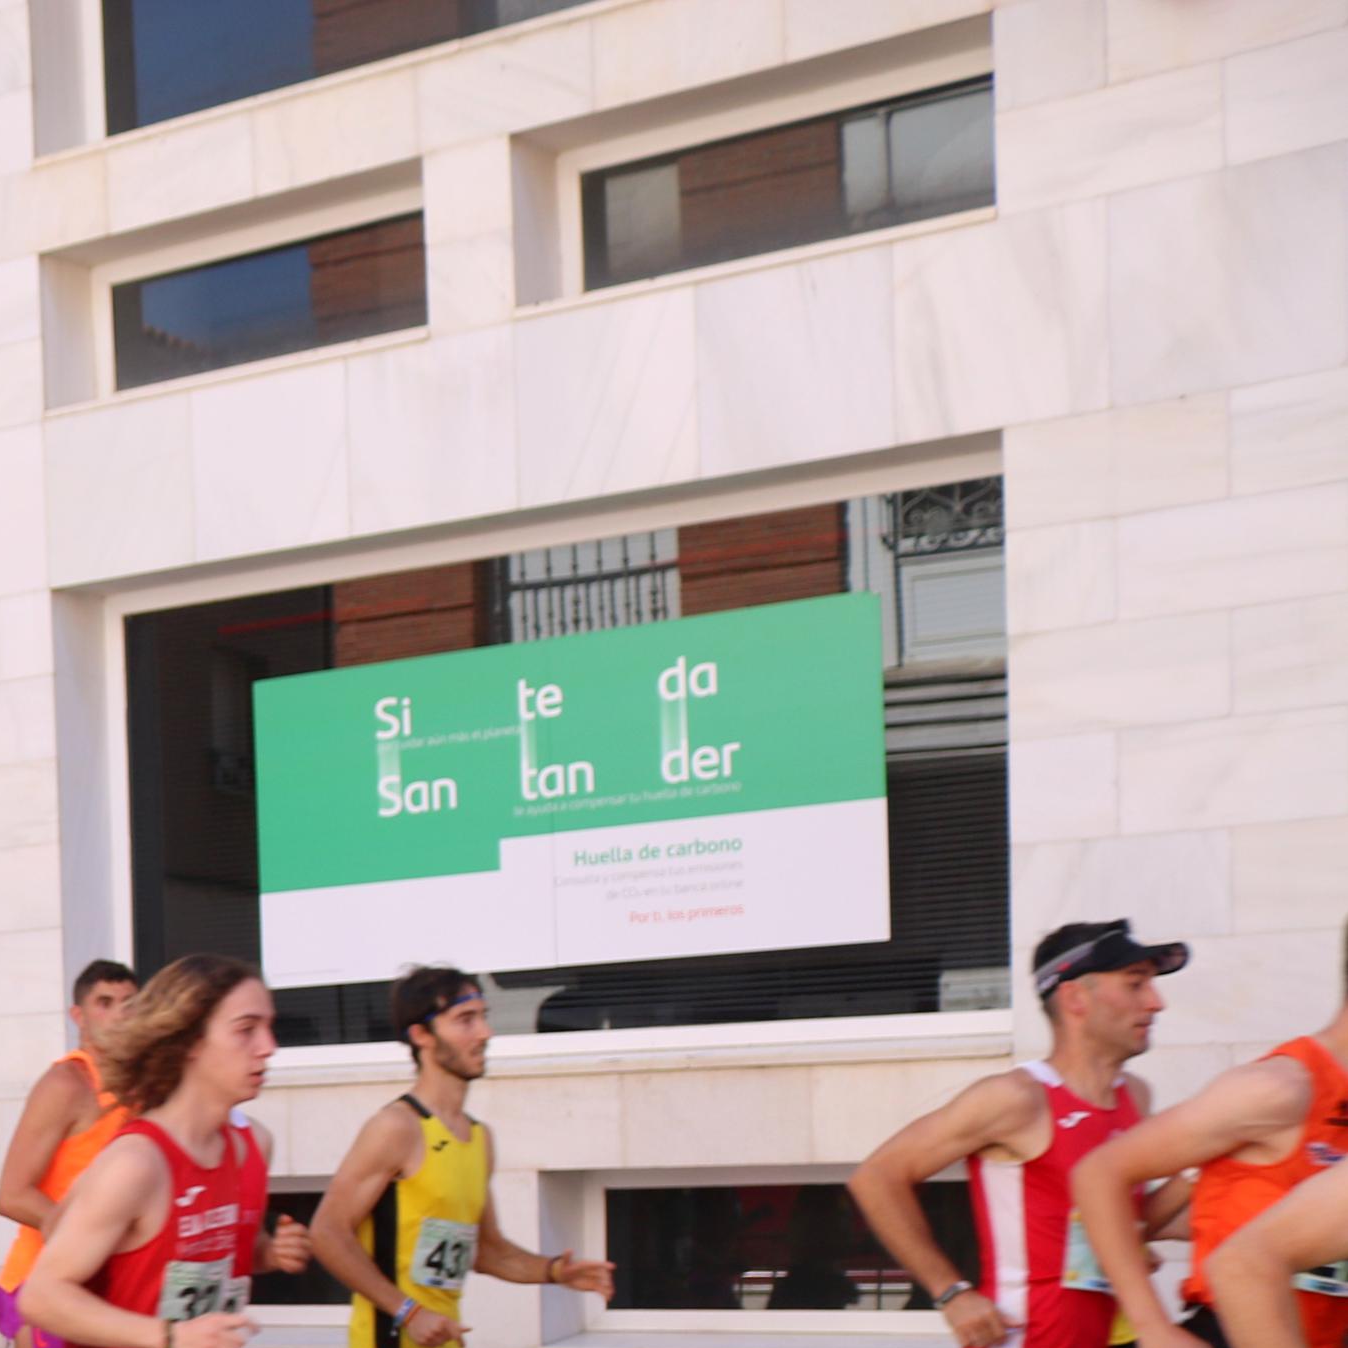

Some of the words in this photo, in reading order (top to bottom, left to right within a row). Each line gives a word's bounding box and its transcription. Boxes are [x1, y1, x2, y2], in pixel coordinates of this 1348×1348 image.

[374, 696, 412, 740] Si
[517, 678, 564, 721] te
[658, 655, 718, 701] da
[378, 775, 458, 818] San
[521, 757, 595, 801] tan
[661, 741, 741, 784] der
[574, 845, 634, 867] Huella
[639, 843, 660, 860] de
[667, 837, 743, 858] carbono
